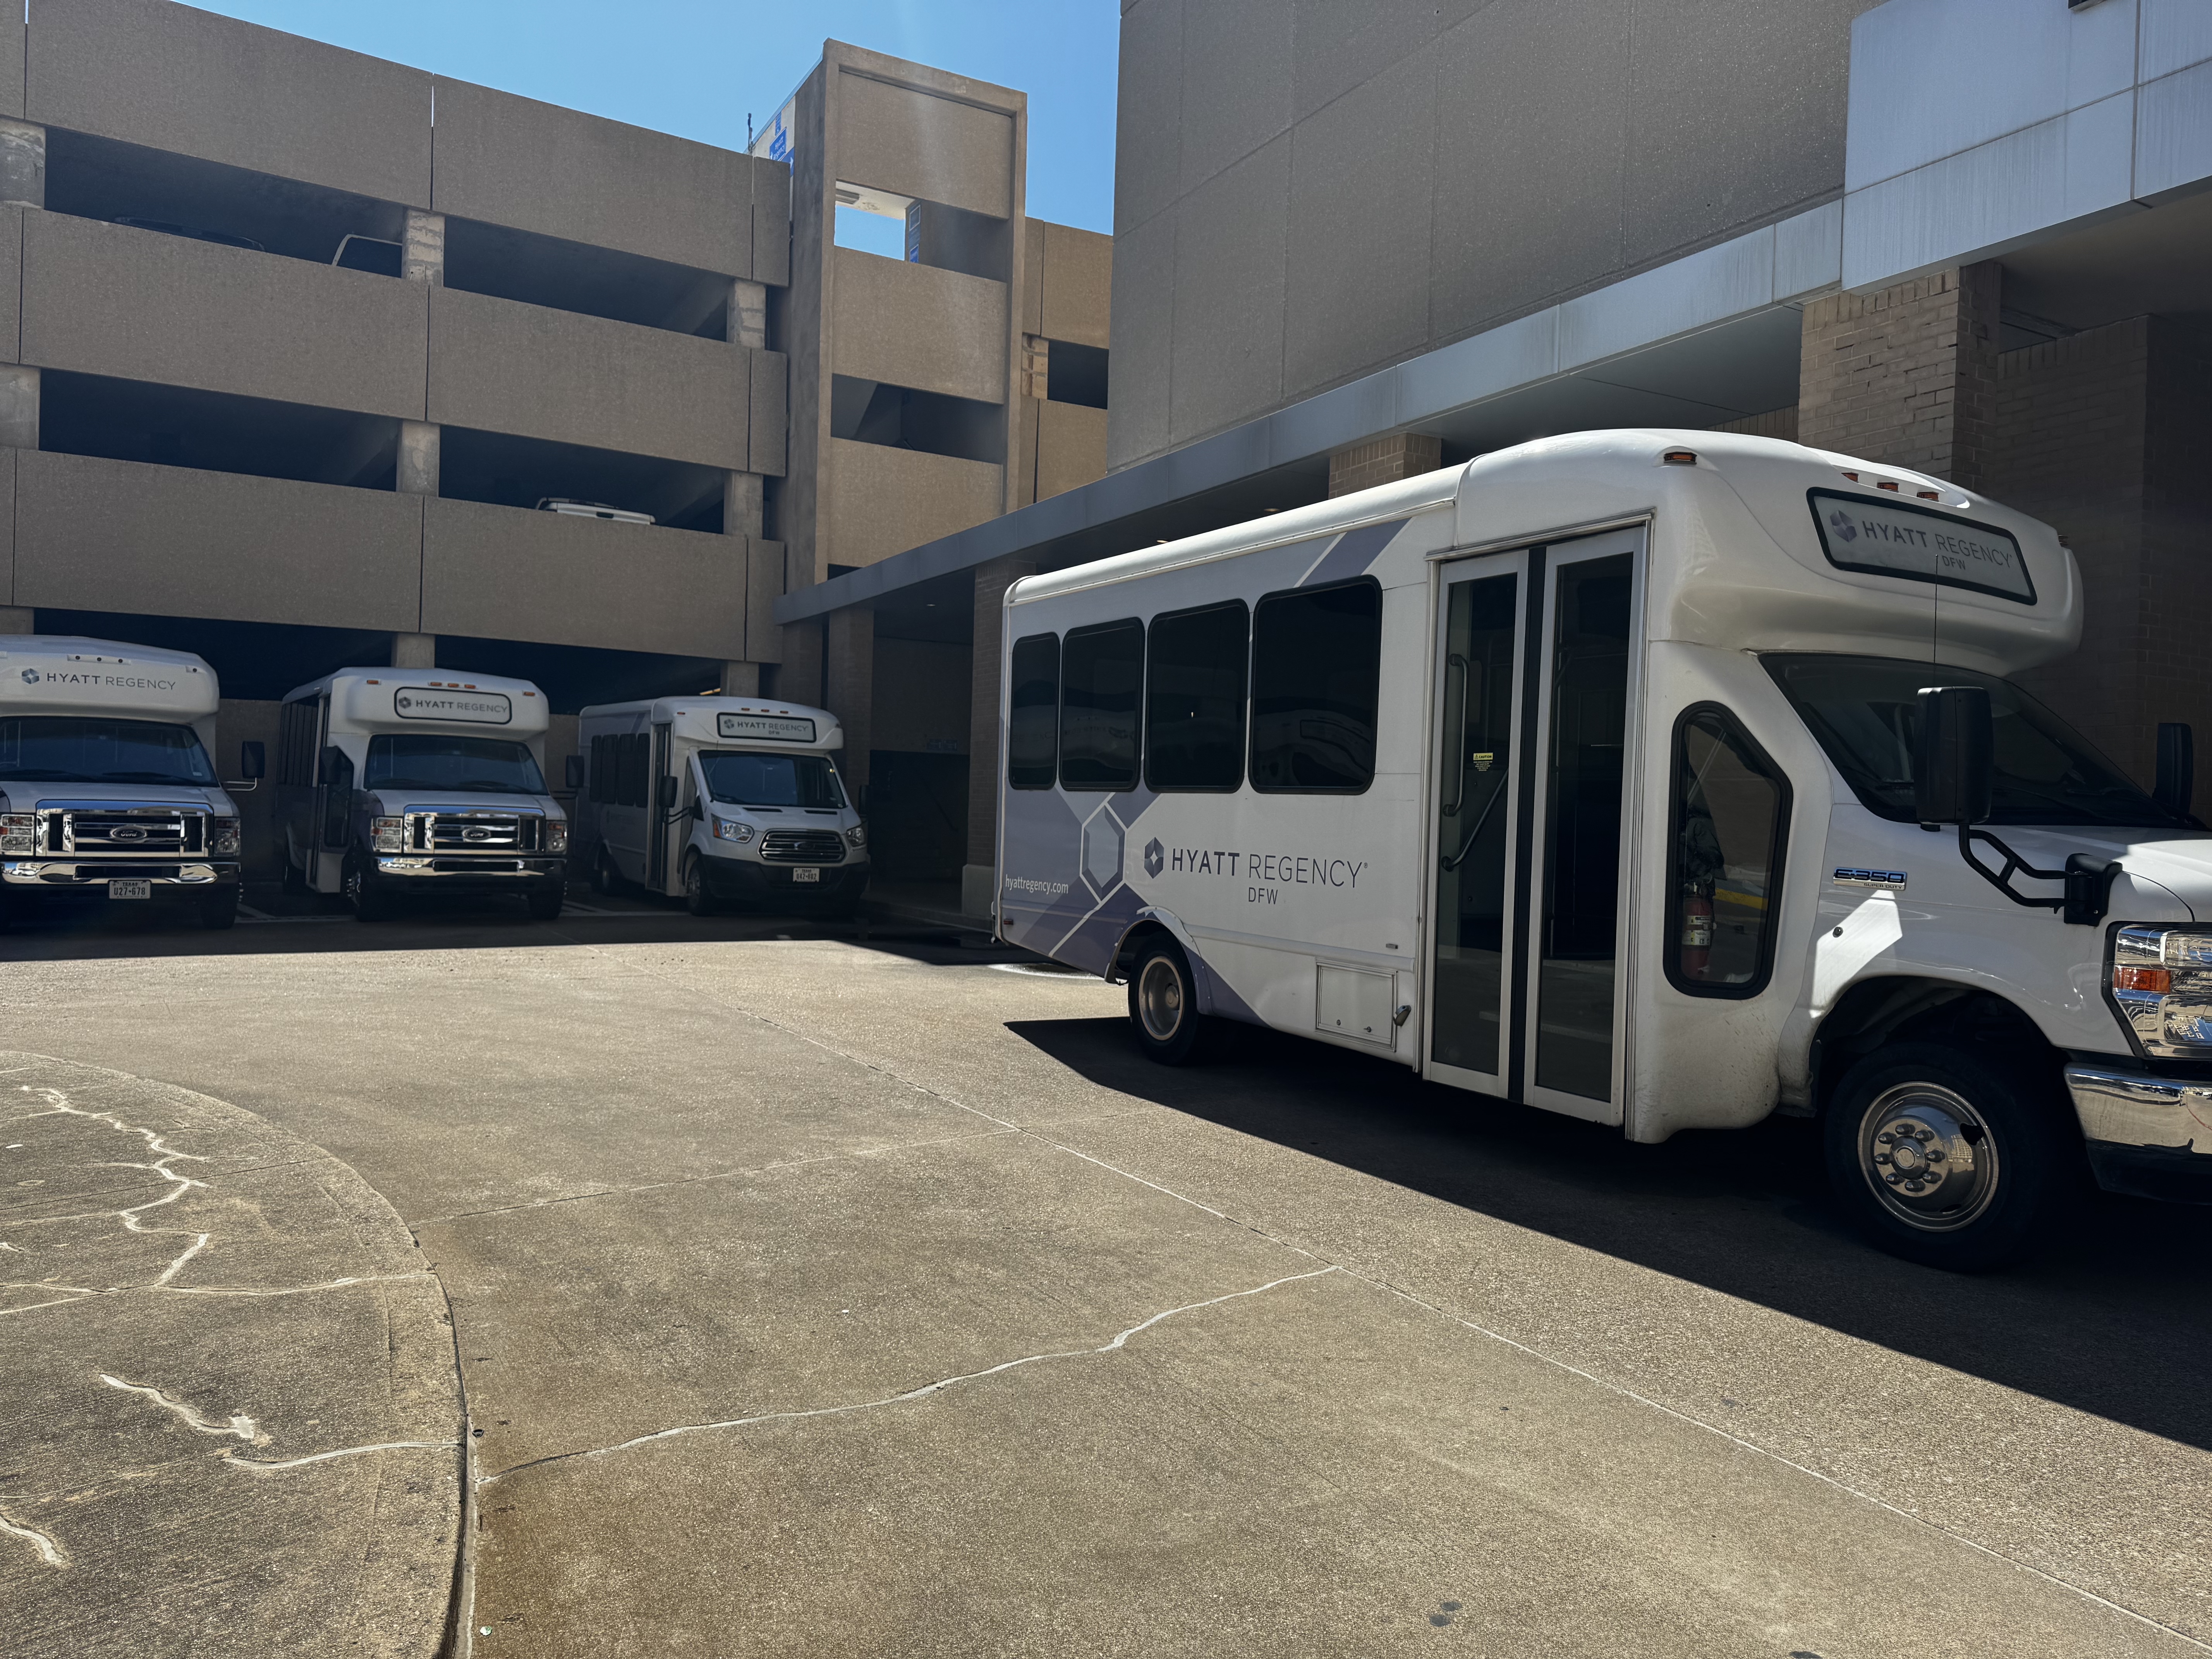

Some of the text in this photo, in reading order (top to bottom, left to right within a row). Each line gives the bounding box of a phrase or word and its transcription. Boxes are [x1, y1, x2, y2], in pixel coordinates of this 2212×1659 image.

[1862, 520, 2010, 568] HYATT REGENCY
[1942, 555, 1966, 570] DFW
[47, 673, 176, 690] HYATT REGENCY
[416, 700, 508, 713] HYATT REGENCY
[737, 721, 807, 732] HYATT REGENCY
[1172, 848, 1240, 876] HYATT
[1005, 874, 1068, 895] hyattregency.com
[1835, 869, 1905, 883] E-350
[1248, 887, 1278, 905] DFW
